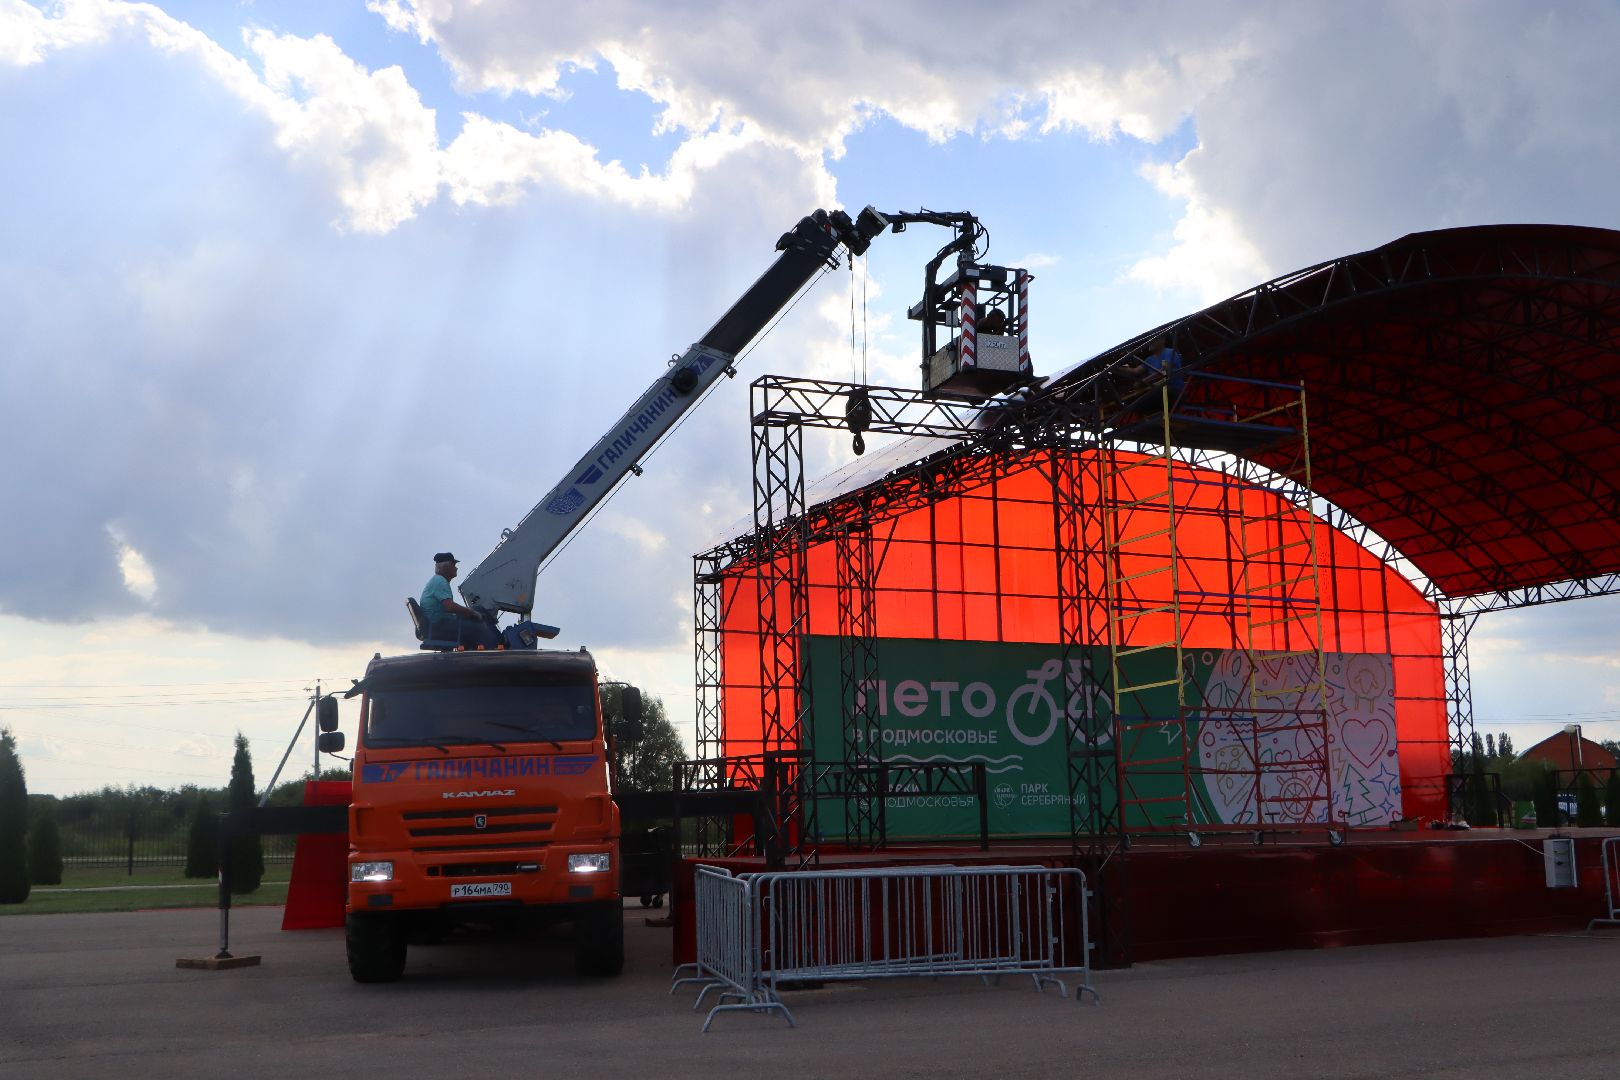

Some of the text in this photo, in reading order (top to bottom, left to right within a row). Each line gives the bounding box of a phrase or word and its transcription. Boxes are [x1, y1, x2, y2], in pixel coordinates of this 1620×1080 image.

[597, 388, 679, 471] ГАЛИЧАНИН
[415, 757, 550, 782] ГАЛИЧАНИН
[442, 789, 516, 799] KAMAZ
[1021, 783, 1049, 794] ПАРК
[883, 796, 974, 808] ОДМОСКОВЬЯ
[1021, 794, 1086, 806] СЕРЕБРЯНЫЙ
